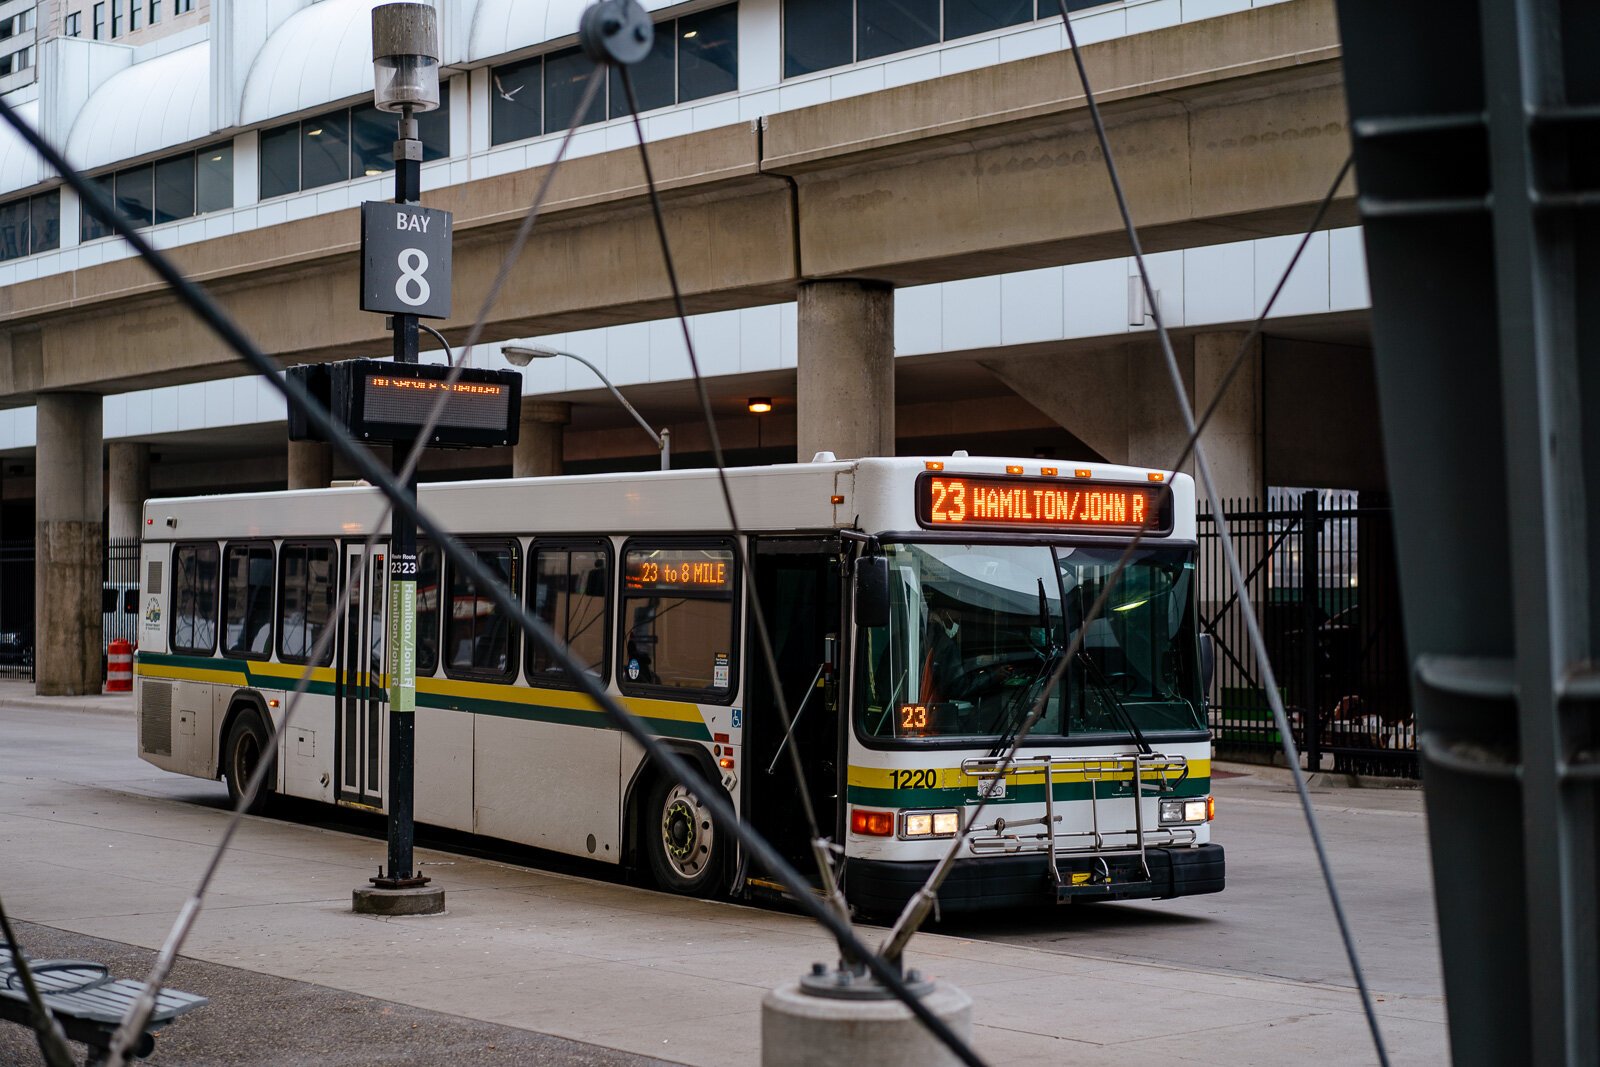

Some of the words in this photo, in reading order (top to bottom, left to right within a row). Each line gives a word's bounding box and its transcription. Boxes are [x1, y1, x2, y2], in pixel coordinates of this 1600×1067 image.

[396, 212, 430, 234] BAY
[395, 248, 430, 306] 8
[931, 481, 966, 521] 23
[973, 487, 1126, 522] HAMILTON/JOHN
[1132, 494, 1144, 522] R
[391, 561, 402, 574] 23
[402, 562, 417, 574] 23
[642, 562, 659, 582] 23
[664, 563, 677, 582] to
[681, 563, 690, 583] 8
[693, 563, 725, 583] MILE
[392, 584, 400, 674] Hamilton/John
[404, 584, 414, 674] Hamilton/John
[392, 678, 399, 686] R
[404, 677, 413, 687] R
[901, 706, 926, 728] 23
[889, 768, 937, 790] 1220
